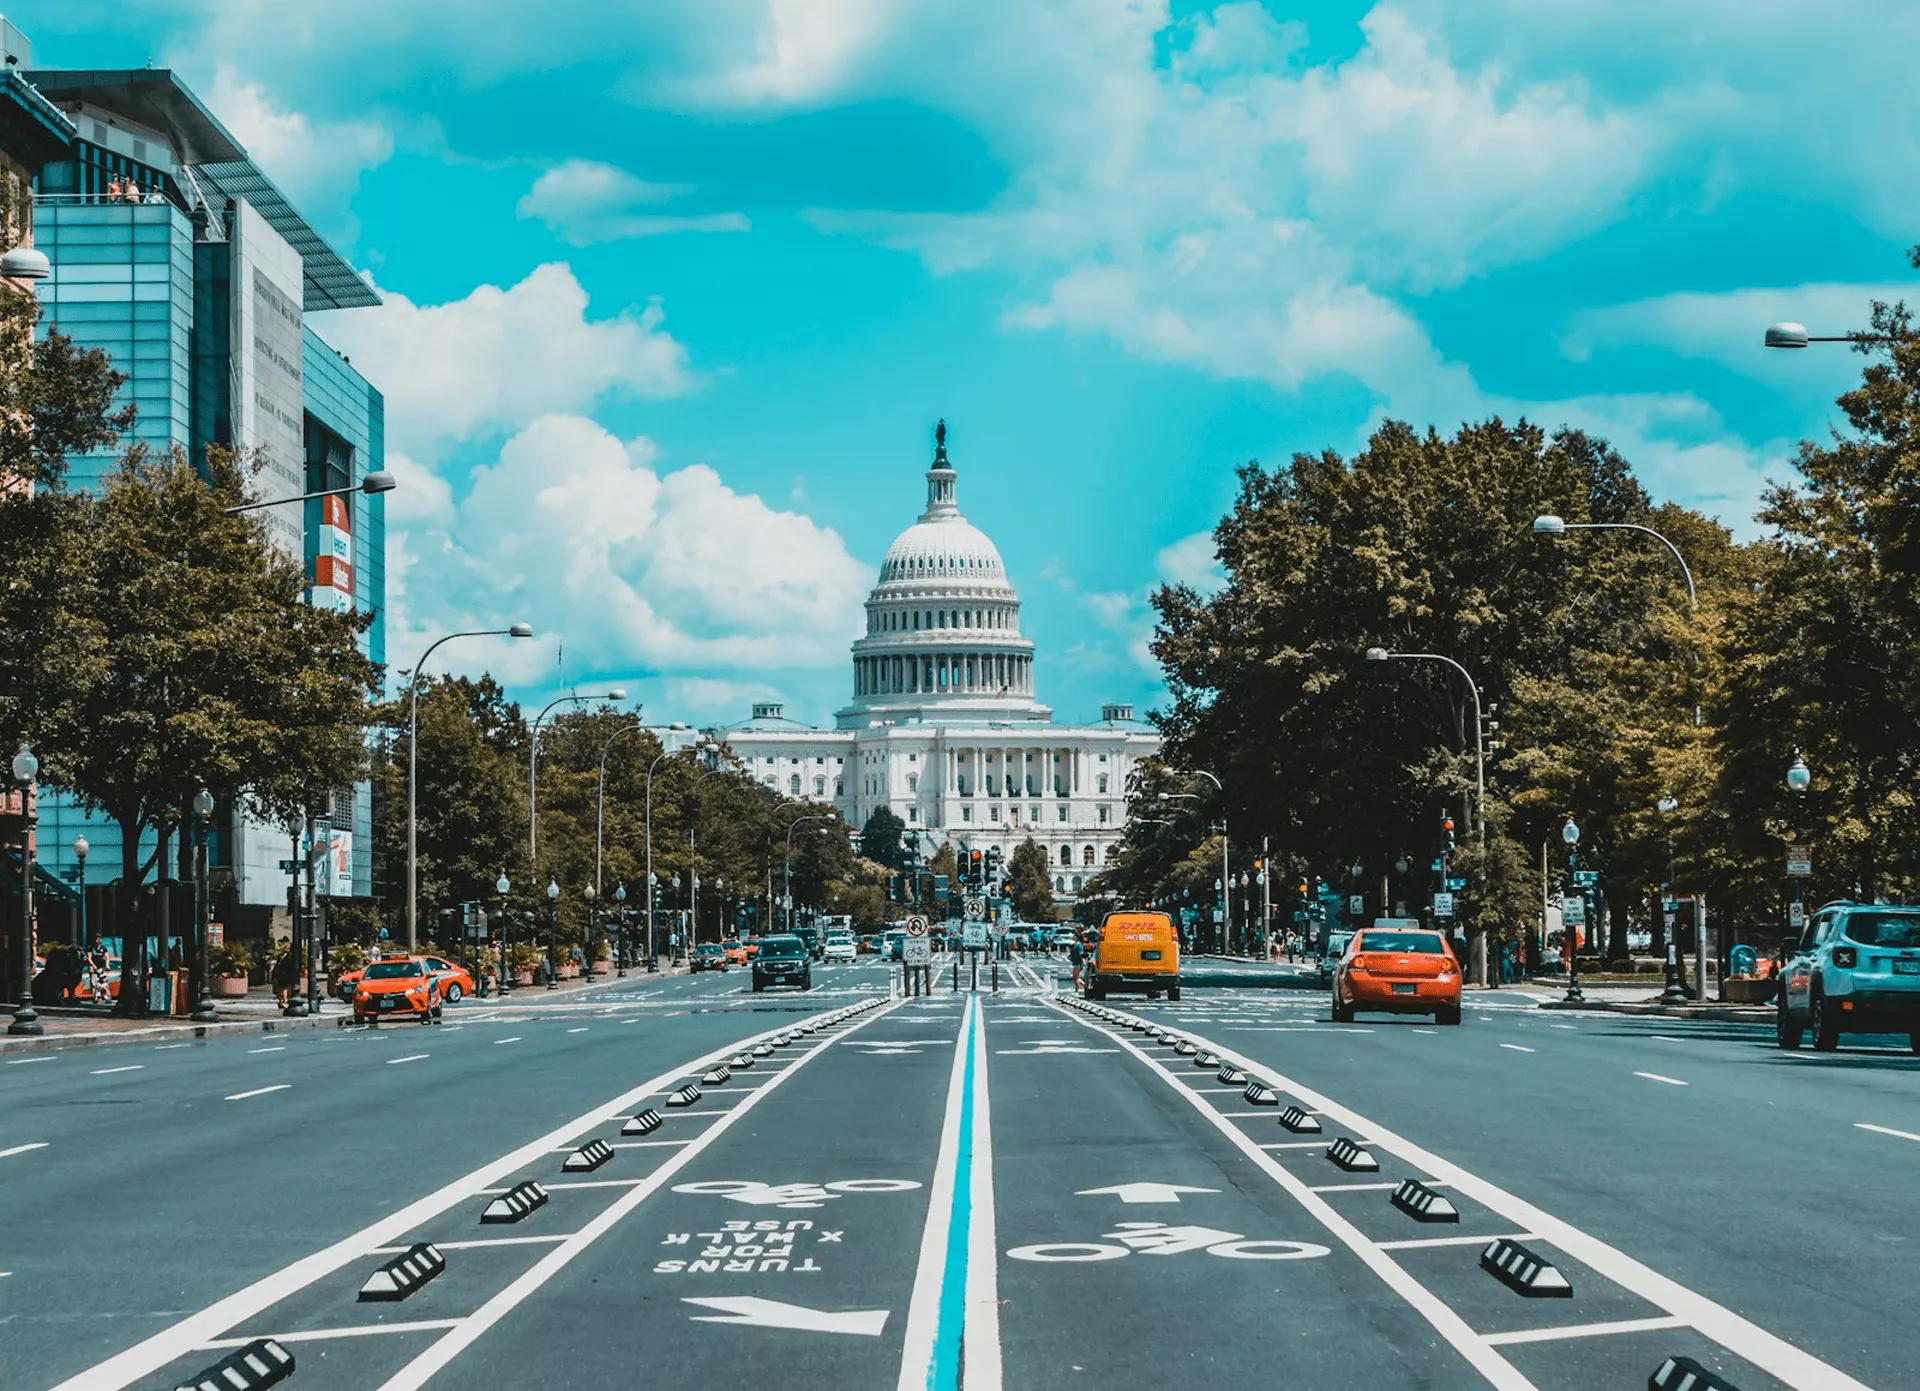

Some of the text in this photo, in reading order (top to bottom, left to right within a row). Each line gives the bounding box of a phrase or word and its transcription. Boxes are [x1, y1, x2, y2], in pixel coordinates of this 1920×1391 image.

[720, 1220, 814, 1231] USE
[661, 1231, 844, 1244] X WALK
[701, 1245, 793, 1257] FOR
[653, 1258, 822, 1273] TURNS
